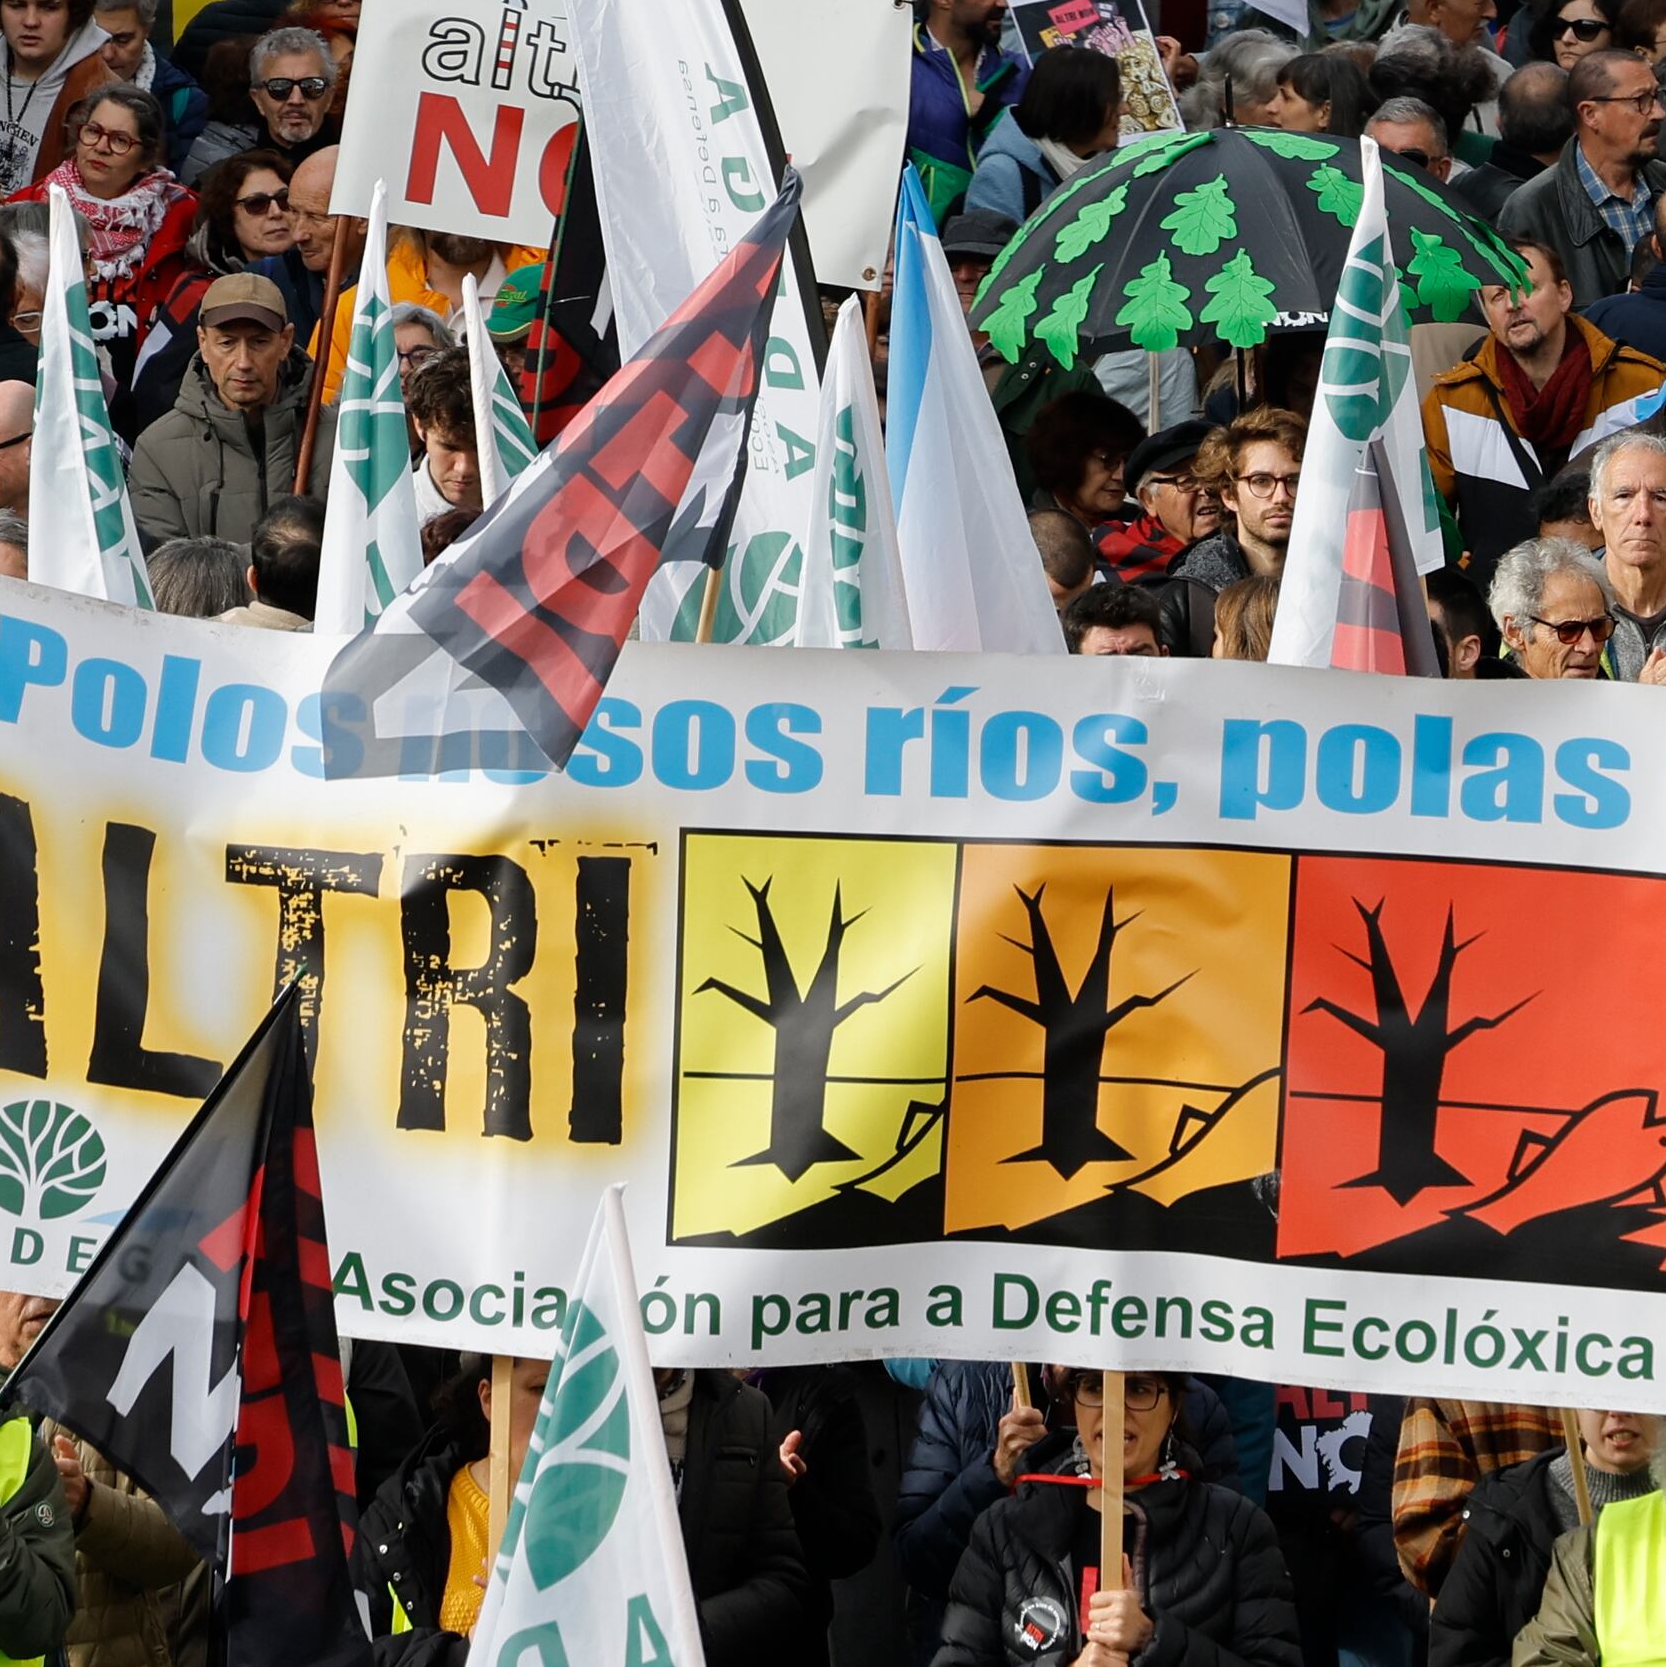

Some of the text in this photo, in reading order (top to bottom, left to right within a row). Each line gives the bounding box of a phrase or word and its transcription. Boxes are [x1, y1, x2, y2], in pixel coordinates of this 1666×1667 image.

[88, 300, 138, 341] ON
[863, 686, 1179, 822] ríos,
[1217, 708, 1632, 832] polas
[332, 1251, 721, 1337] Asociaón
[751, 1284, 902, 1351] para
[925, 1284, 965, 1328] a
[992, 1271, 1277, 1351] Defensa
[1301, 1296, 1656, 1383] Ecolóxica
